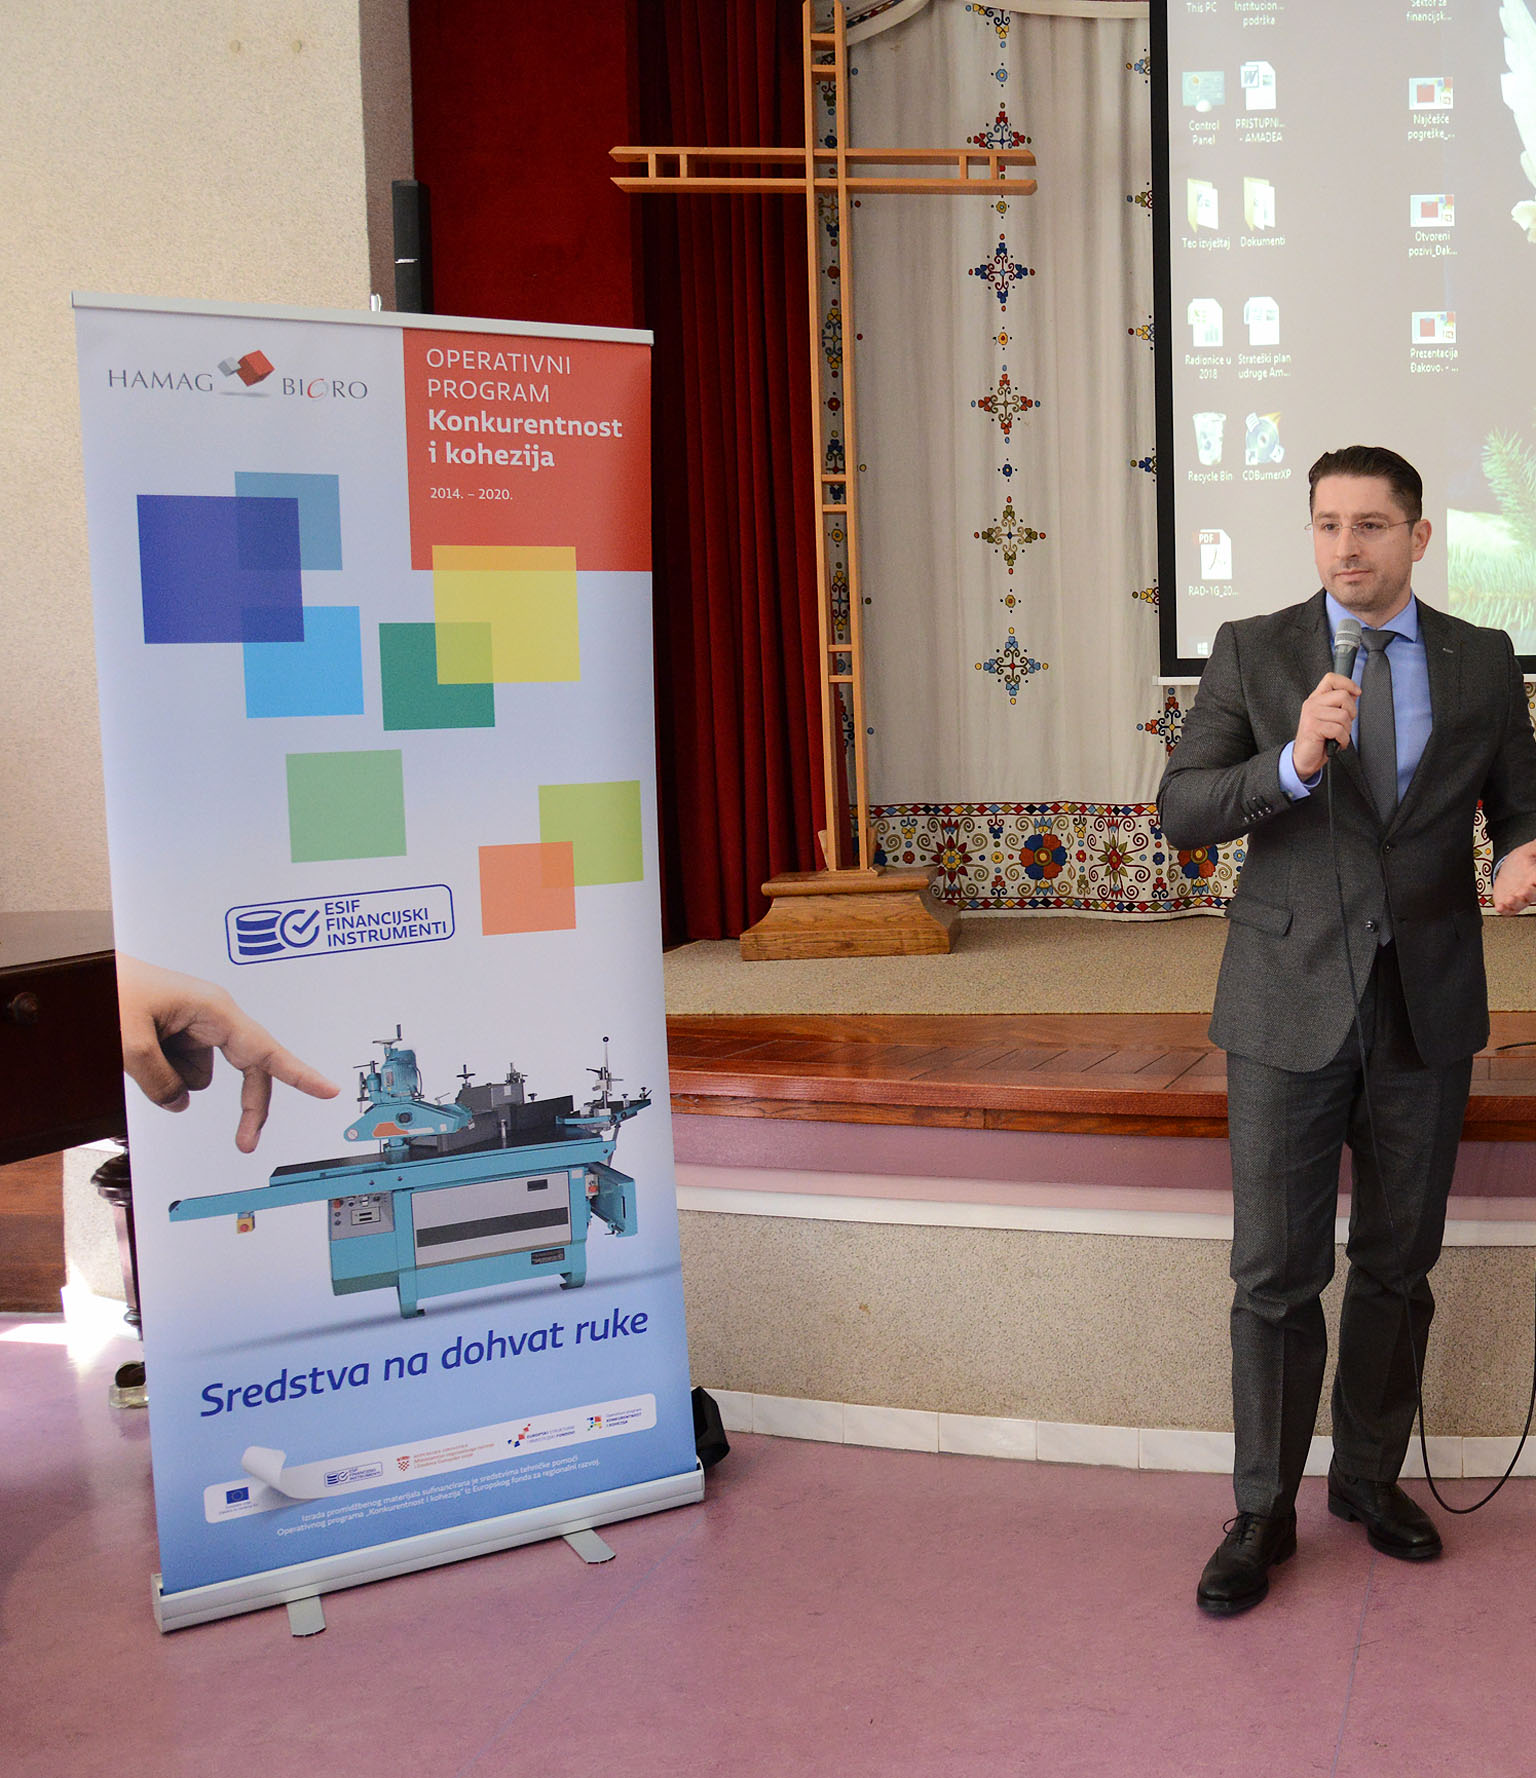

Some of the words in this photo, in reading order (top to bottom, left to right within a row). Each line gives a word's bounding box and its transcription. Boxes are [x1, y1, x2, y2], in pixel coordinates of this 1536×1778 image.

[1188, 119, 1220, 131] Control
[1192, 133, 1216, 145] Panel
[1245, 132, 1283, 143] AMADEA
[1240, 235, 1286, 248] Dokumenti
[1415, 230, 1451, 242] Otvoreni
[1184, 353, 1224, 367] Radionice
[1273, 352, 1291, 366] plan
[1410, 347, 1459, 361] Prezentacija
[426, 347, 573, 376] OPERATIVNI
[107, 368, 214, 393] HAMAG
[1198, 367, 1218, 380] 2018
[427, 377, 551, 404] PROGRAM
[428, 408, 624, 440] Konkurentnost
[429, 440, 437, 465] i
[445, 441, 556, 472] kohezija
[430, 486, 464, 501] 2014.
[478, 488, 514, 501] 2020.
[1199, 533, 1215, 544] PDF
[324, 899, 360, 916] ESIF
[326, 907, 429, 932] FINANCIJSKI
[327, 920, 447, 948] INSTRUMENTI
[200, 1361, 371, 1418] Sredstva
[383, 1350, 429, 1382] na
[440, 1319, 565, 1370] dohvat
[575, 1306, 649, 1345] ruke
